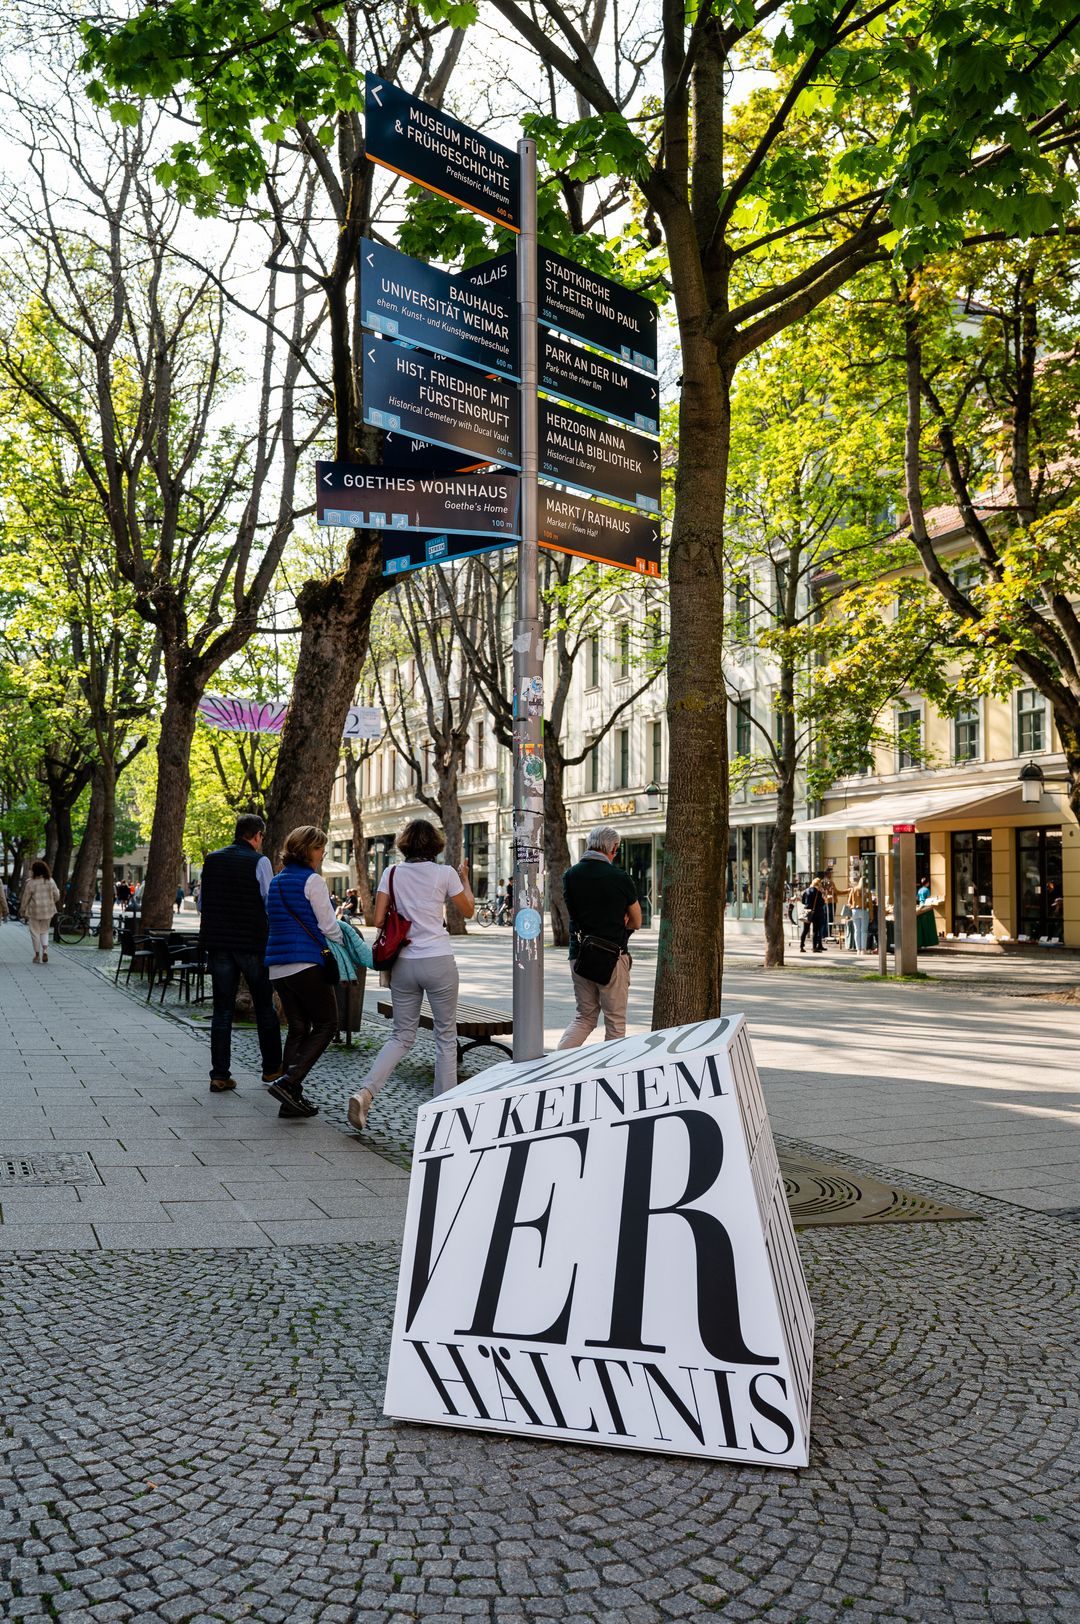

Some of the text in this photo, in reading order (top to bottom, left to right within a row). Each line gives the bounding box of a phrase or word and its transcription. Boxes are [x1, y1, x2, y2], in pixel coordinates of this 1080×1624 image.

[394, 119, 510, 191] & FRÜHGESCHICHTE
[410, 107, 510, 170] MUSEUM FÜR UR-
[446, 166, 510, 205] Prehistoric Museum
[545, 259, 611, 302] STADTKIRCHE
[381, 278, 509, 340] UNIVERSITÄT WEIMAR
[449, 286, 509, 319] BAUHAUS-
[545, 277, 640, 333] ST. PETER UND PAUL
[546, 295, 585, 320] Herderstätten
[376, 297, 510, 355] ehem. Kunst- und Kunstgewerbeschule
[396, 357, 427, 381] HIST.
[430, 370, 488, 401] FRIEDHOF
[490, 391, 510, 409] MIT
[545, 344, 628, 389] PARK AN DER ILM
[546, 362, 602, 392] Park on the river Ilm
[388, 395, 510, 443] Historical Cemetery with Ducal Vault
[419, 385, 510, 428] FÜRSTENGRUFT
[546, 412, 626, 451] HERZOGIN ANNA
[546, 431, 642, 474] AMALIA BIBLIOTHEK
[543, 461, 554, 472] 250
[547, 448, 597, 474] Historical Library
[343, 474, 508, 499] GOETHES WOHNHAUS
[444, 500, 509, 514] Goethe's Home
[492, 518, 505, 527] 100
[546, 498, 581, 520] MARKT
[587, 510, 631, 534] RATHAUS
[547, 518, 567, 531] Market
[572, 523, 586, 534] Town
[346, 713, 360, 735] 2
[418, 1103, 486, 1154] IN
[492, 1053, 729, 1140] KEINEM
[405, 1110, 780, 1366] VER
[402, 1338, 796, 1456] HÄLTNIS
